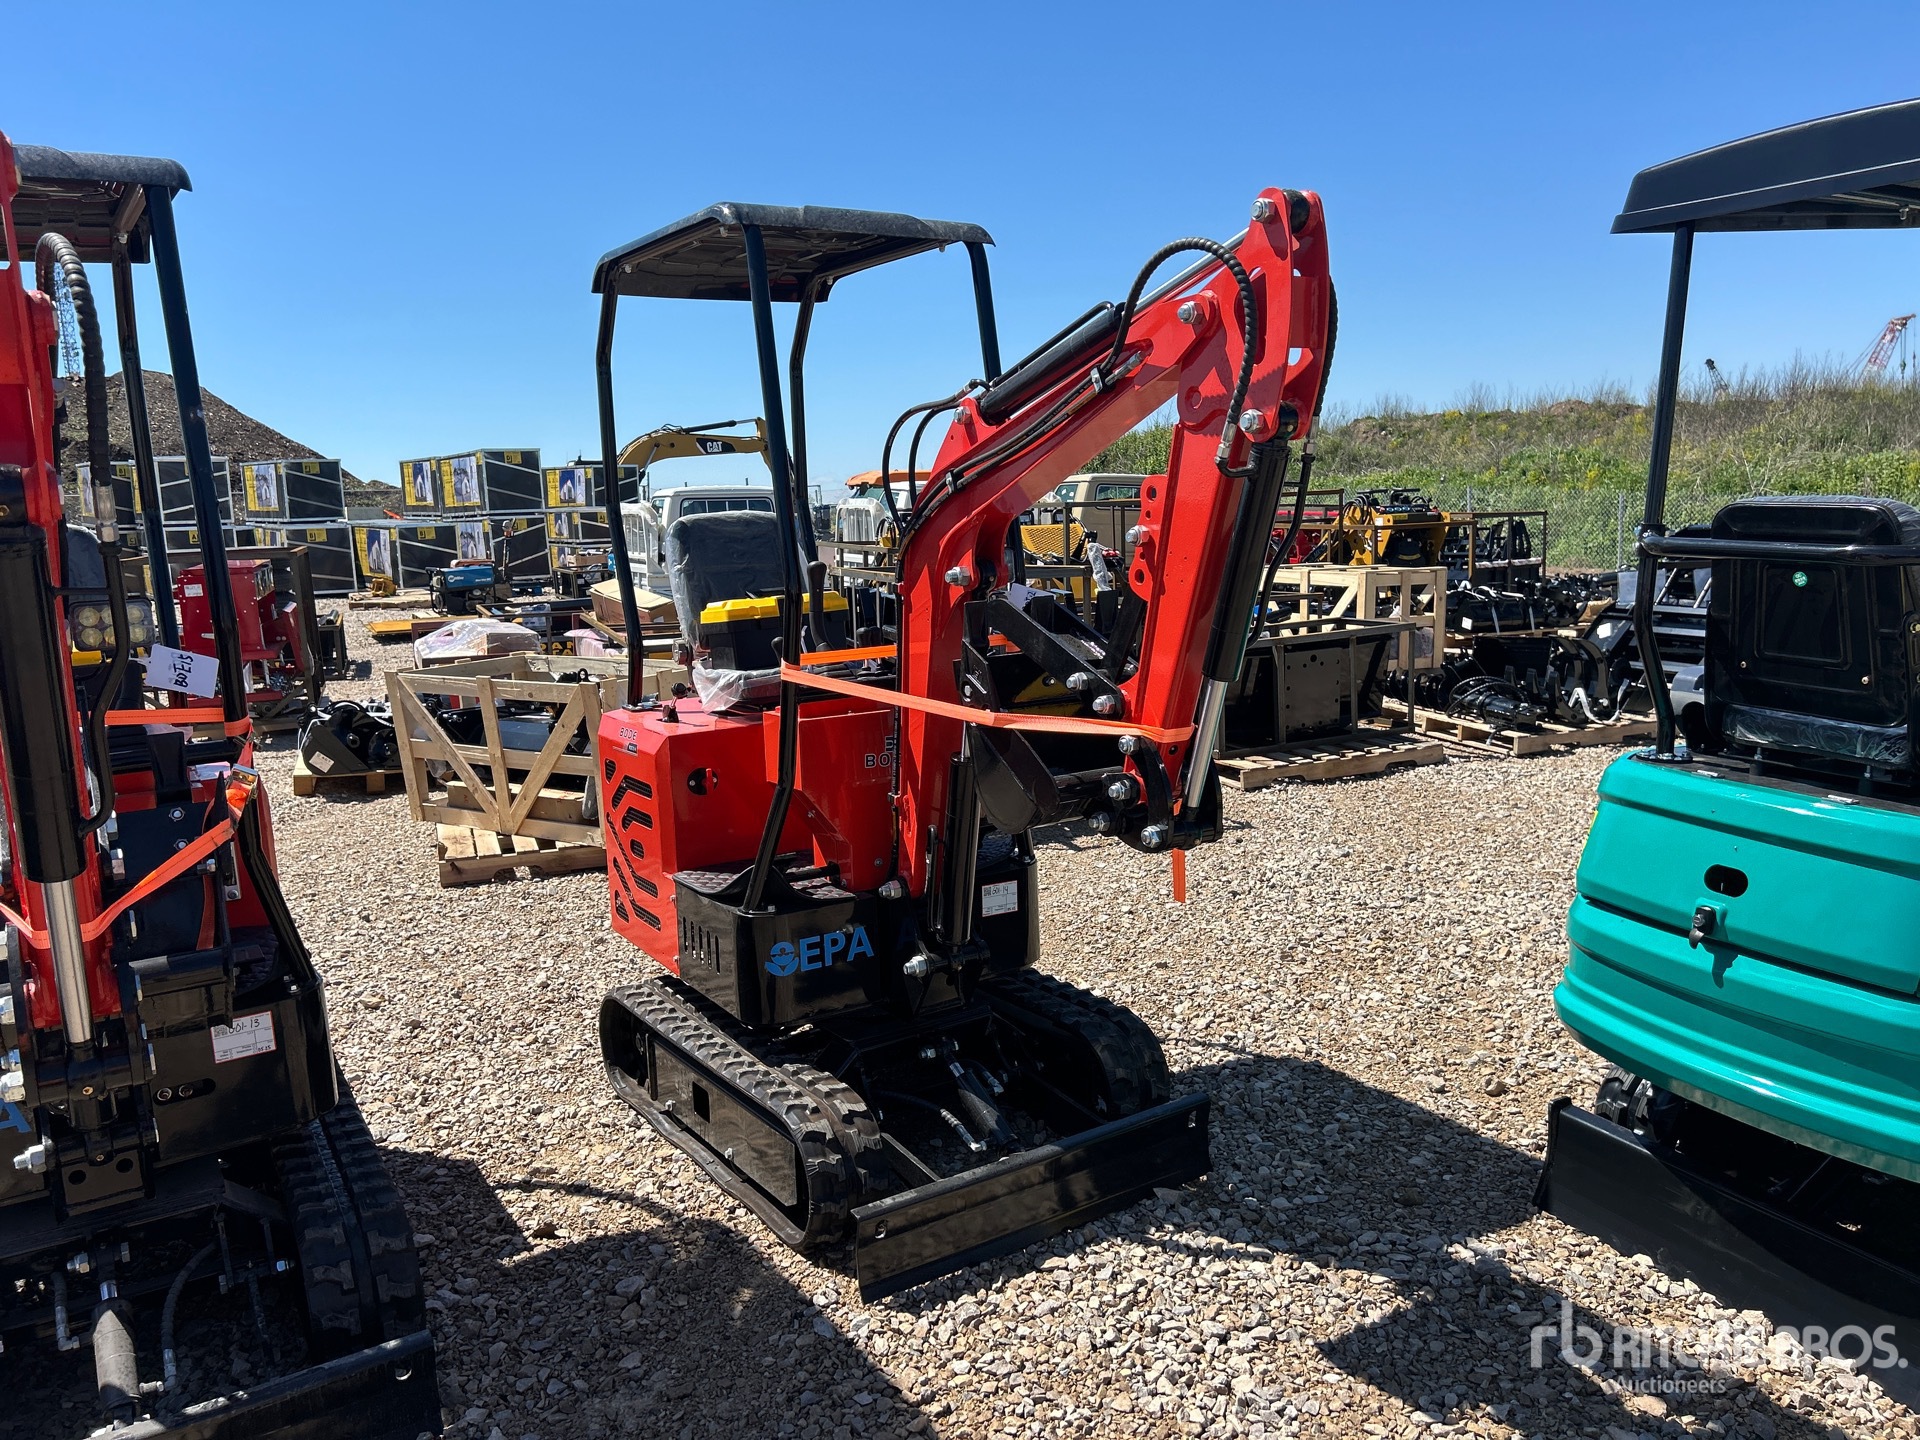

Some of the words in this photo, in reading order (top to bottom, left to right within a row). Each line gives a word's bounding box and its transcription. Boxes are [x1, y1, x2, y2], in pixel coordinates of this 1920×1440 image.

[706, 441, 723, 453] CAT
[619, 726, 638, 741] BODE
[799, 925, 875, 972] EPA
